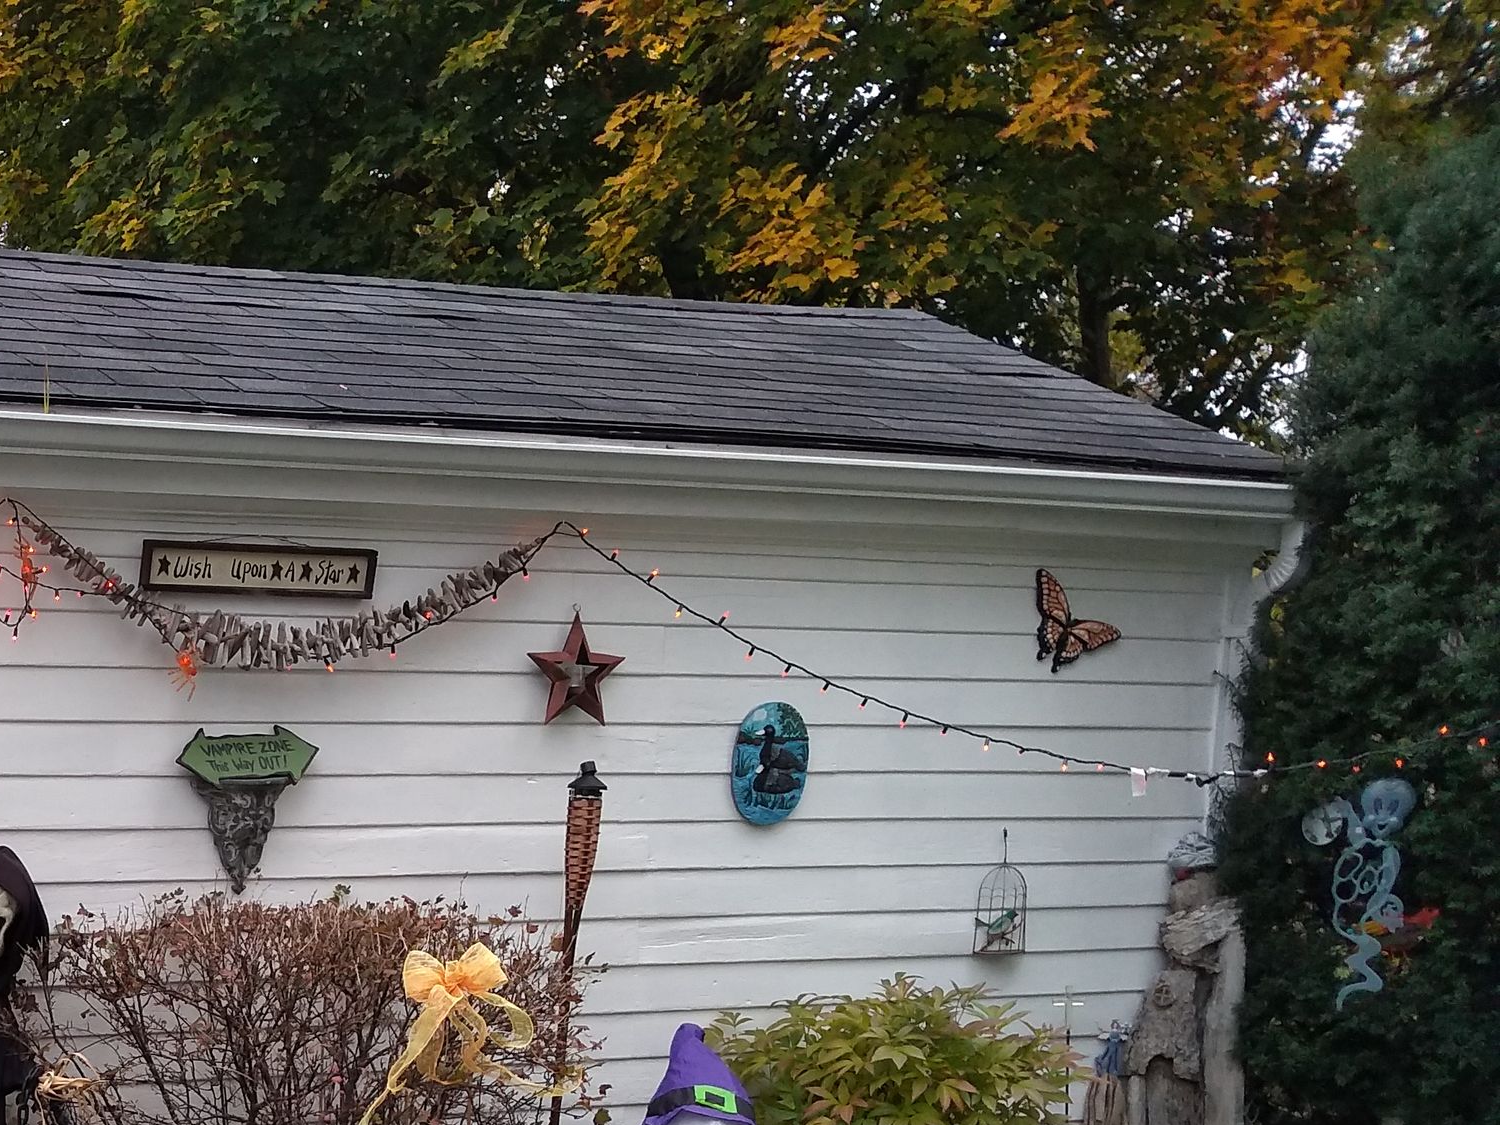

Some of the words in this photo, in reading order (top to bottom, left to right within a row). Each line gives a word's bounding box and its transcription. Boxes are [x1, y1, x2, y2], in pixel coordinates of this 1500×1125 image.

[173, 555, 212, 579] Wish
[231, 558, 267, 583] Upon
[284, 560, 295, 582] A
[314, 559, 344, 585] Star
[200, 742, 257, 757] VAMPIRE
[258, 740, 295, 753] ZONE
[206, 760, 230, 772] This
[231, 758, 255, 773] Way
[258, 754, 287, 770] OUT!
